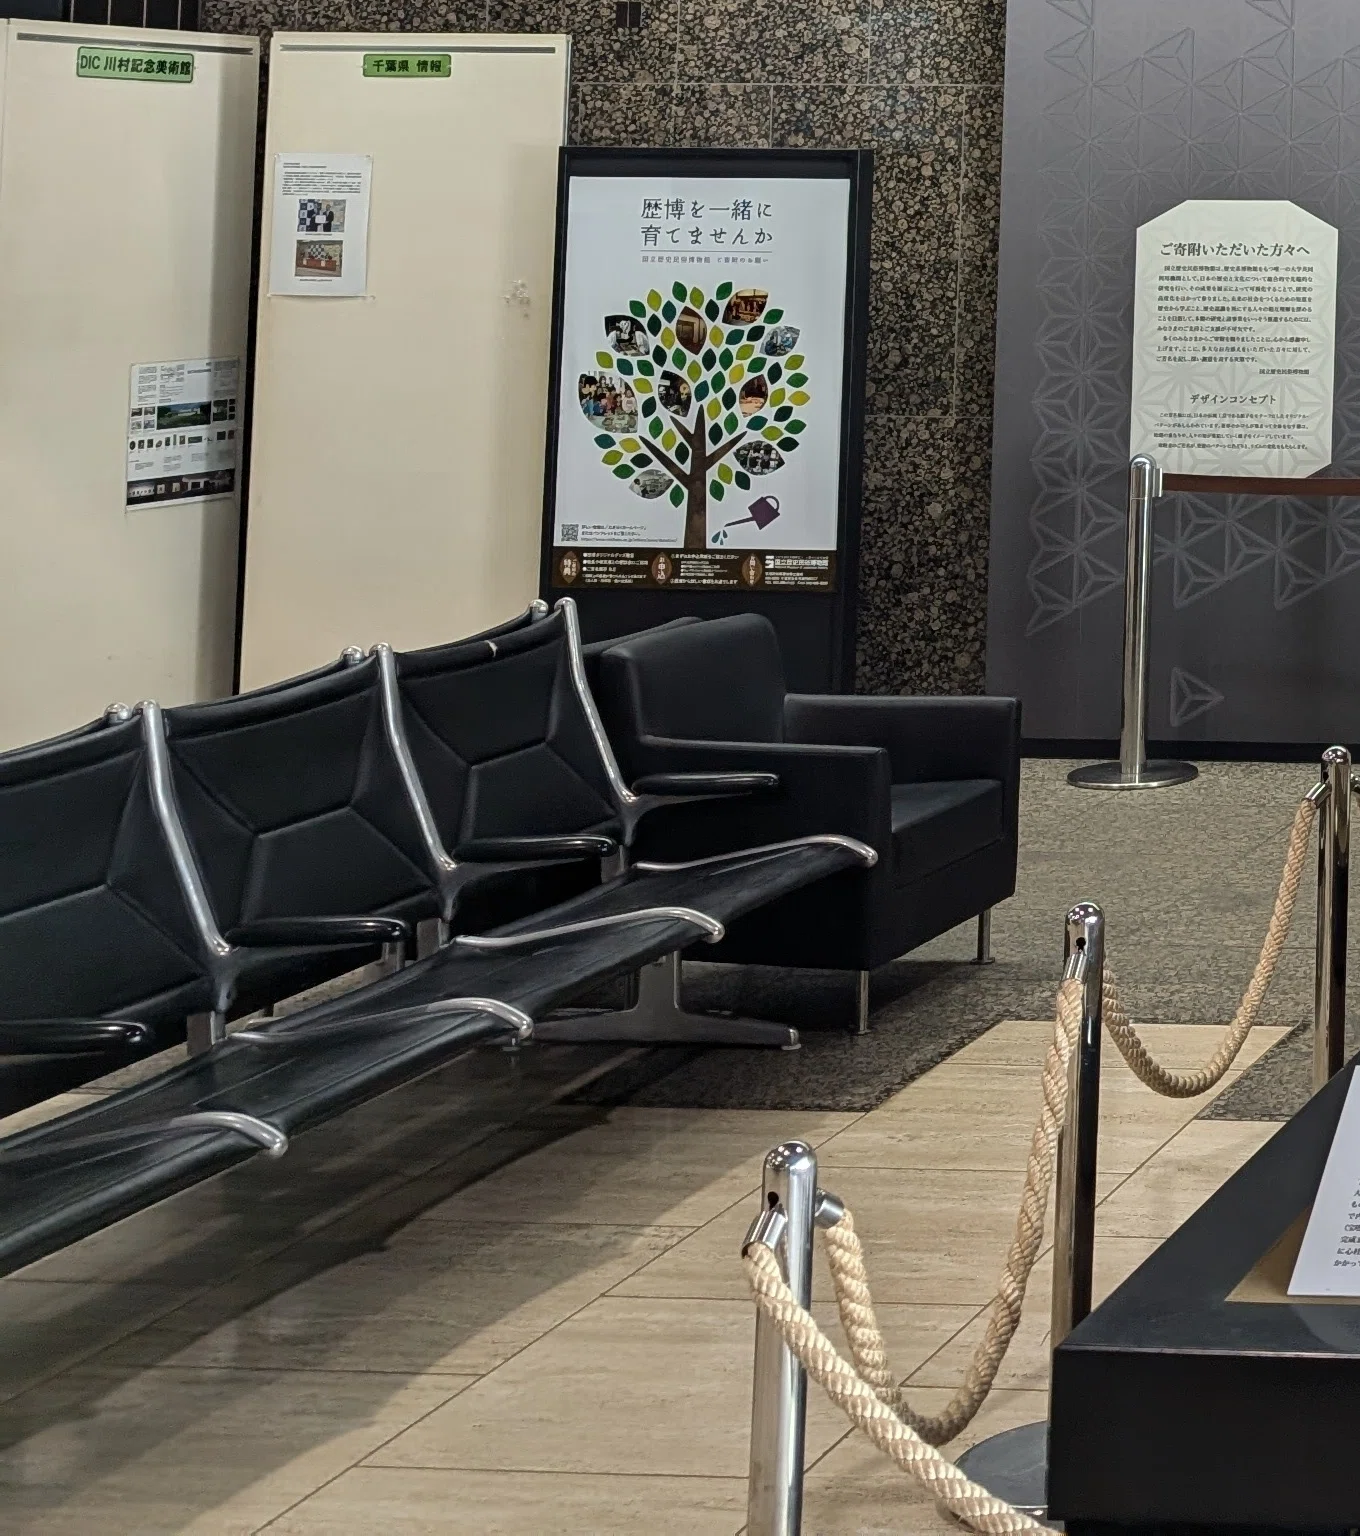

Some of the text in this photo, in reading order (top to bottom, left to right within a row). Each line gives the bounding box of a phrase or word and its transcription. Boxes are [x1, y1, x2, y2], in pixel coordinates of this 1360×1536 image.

[80, 54, 192, 76] DIC 川村記念美術館
[372, 59, 442, 73] 千葉県 情報
[640, 197, 773, 221] 歴博を一緒に
[640, 224, 773, 247] 育てませんか
[1160, 242, 1311, 258] ご寄附いただいた方々へ
[1190, 393, 1277, 405] デザインコンセプト
